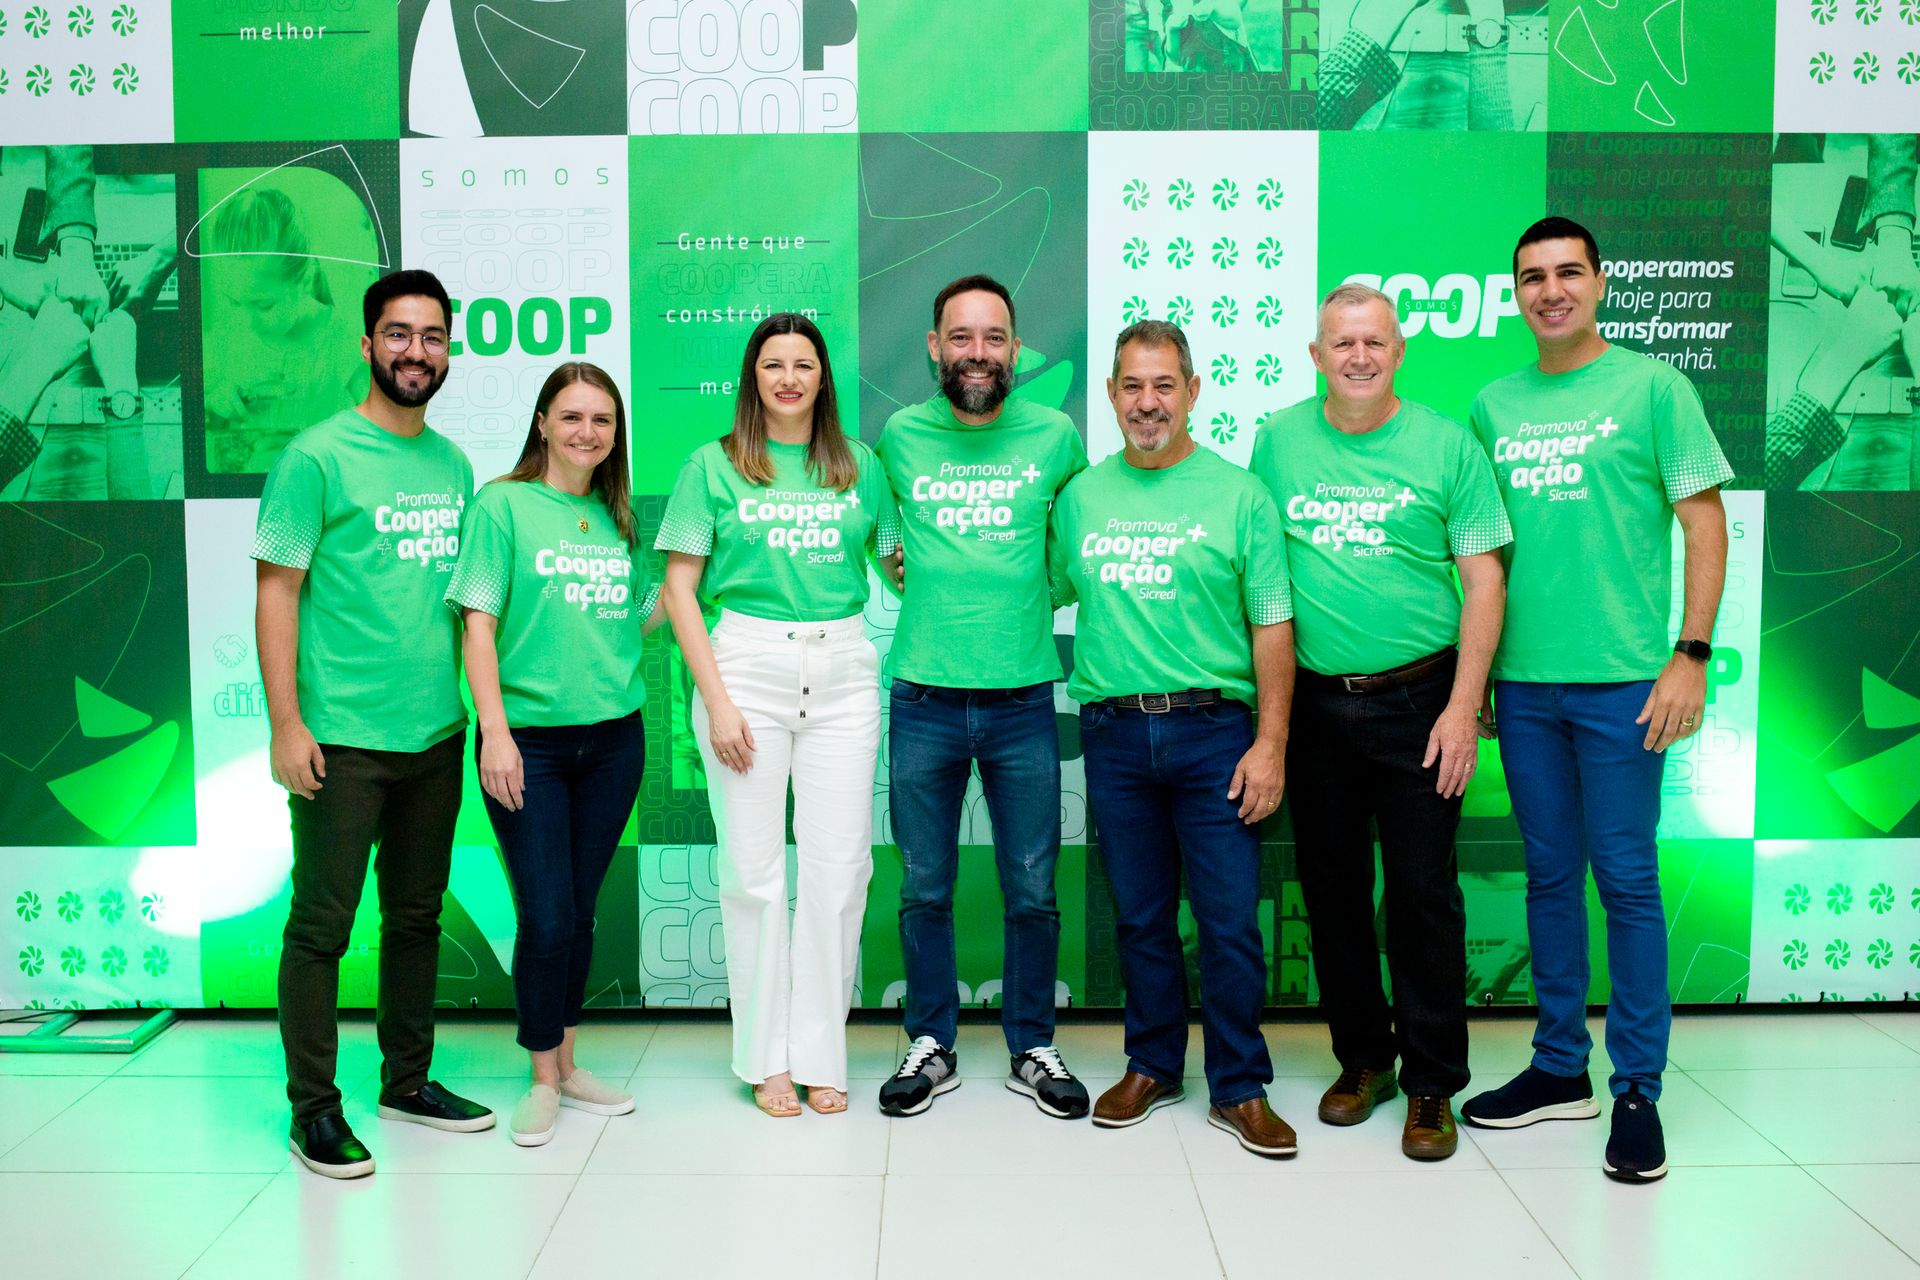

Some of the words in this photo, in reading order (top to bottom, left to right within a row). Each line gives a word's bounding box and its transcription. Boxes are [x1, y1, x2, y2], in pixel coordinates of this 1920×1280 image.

[240, 22, 327, 40] melhor
[421, 168, 609, 187] somos
[678, 233, 749, 250] Gente
[762, 236, 805, 254] que
[1599, 255, 1735, 283] ooperamos
[657, 262, 831, 296] COOPERA
[1405, 301, 1457, 311] SOMOS
[1606, 285, 1654, 314] hoje
[1658, 291, 1712, 314] para
[666, 304, 771, 323] constrói
[1595, 316, 1732, 345] ransformar
[1517, 420, 1588, 437] Promova
[939, 462, 1012, 477] Promova
[1510, 457, 1583, 496] ação
[396, 491, 451, 507] Promova
[765, 488, 836, 501] Promova
[1314, 483, 1386, 498] Promova
[1548, 487, 1588, 502] Sicredi
[936, 499, 1012, 535] ação
[1106, 518, 1178, 533] Promova
[767, 521, 840, 557] ação
[977, 529, 1016, 541] Sicredi
[1311, 521, 1386, 551] ação
[397, 528, 459, 567] ação
[559, 539, 623, 556] Promova
[807, 551, 845, 563] Sicredi
[1100, 556, 1173, 591] ação
[564, 577, 629, 611] ação
[1138, 587, 1177, 600] Sicredi
[595, 608, 630, 619] Sicredi
